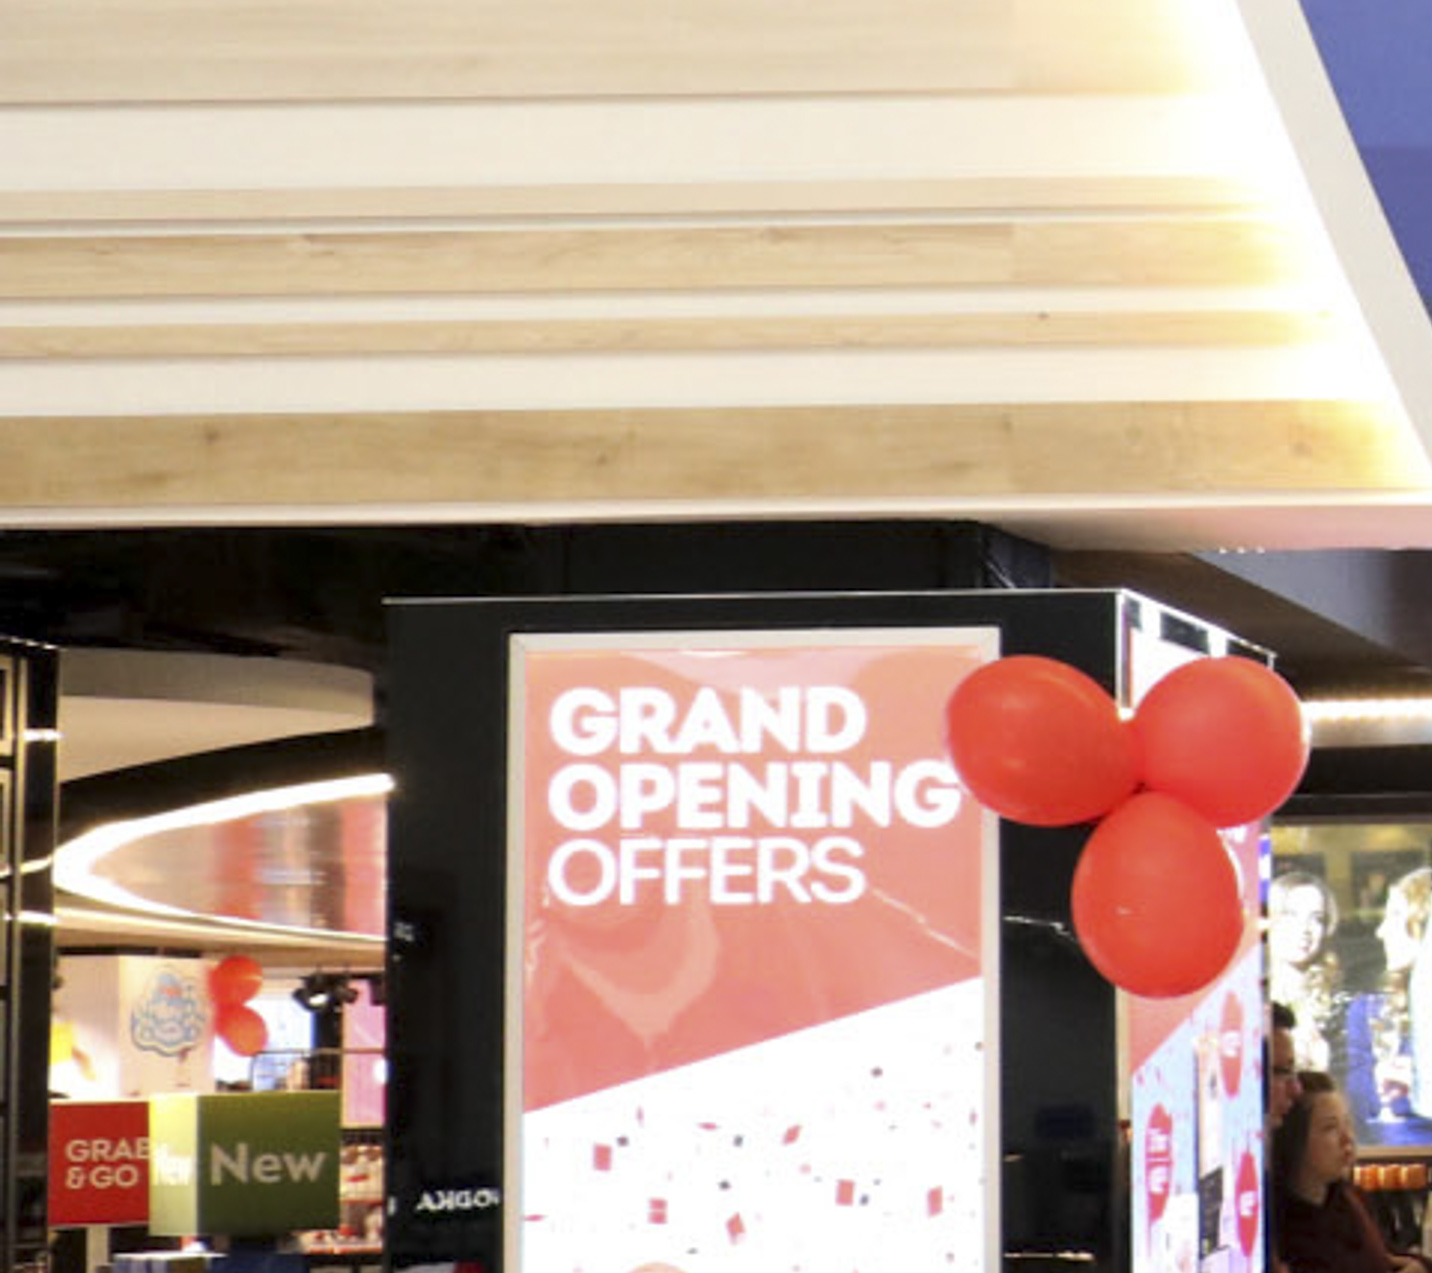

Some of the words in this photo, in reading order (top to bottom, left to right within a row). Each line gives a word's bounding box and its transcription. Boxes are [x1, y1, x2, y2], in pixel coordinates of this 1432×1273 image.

[547, 685, 868, 755] GRAND
[547, 761, 962, 832] OPENING
[547, 835, 867, 907] OFFERS
[210, 1141, 327, 1185] New
